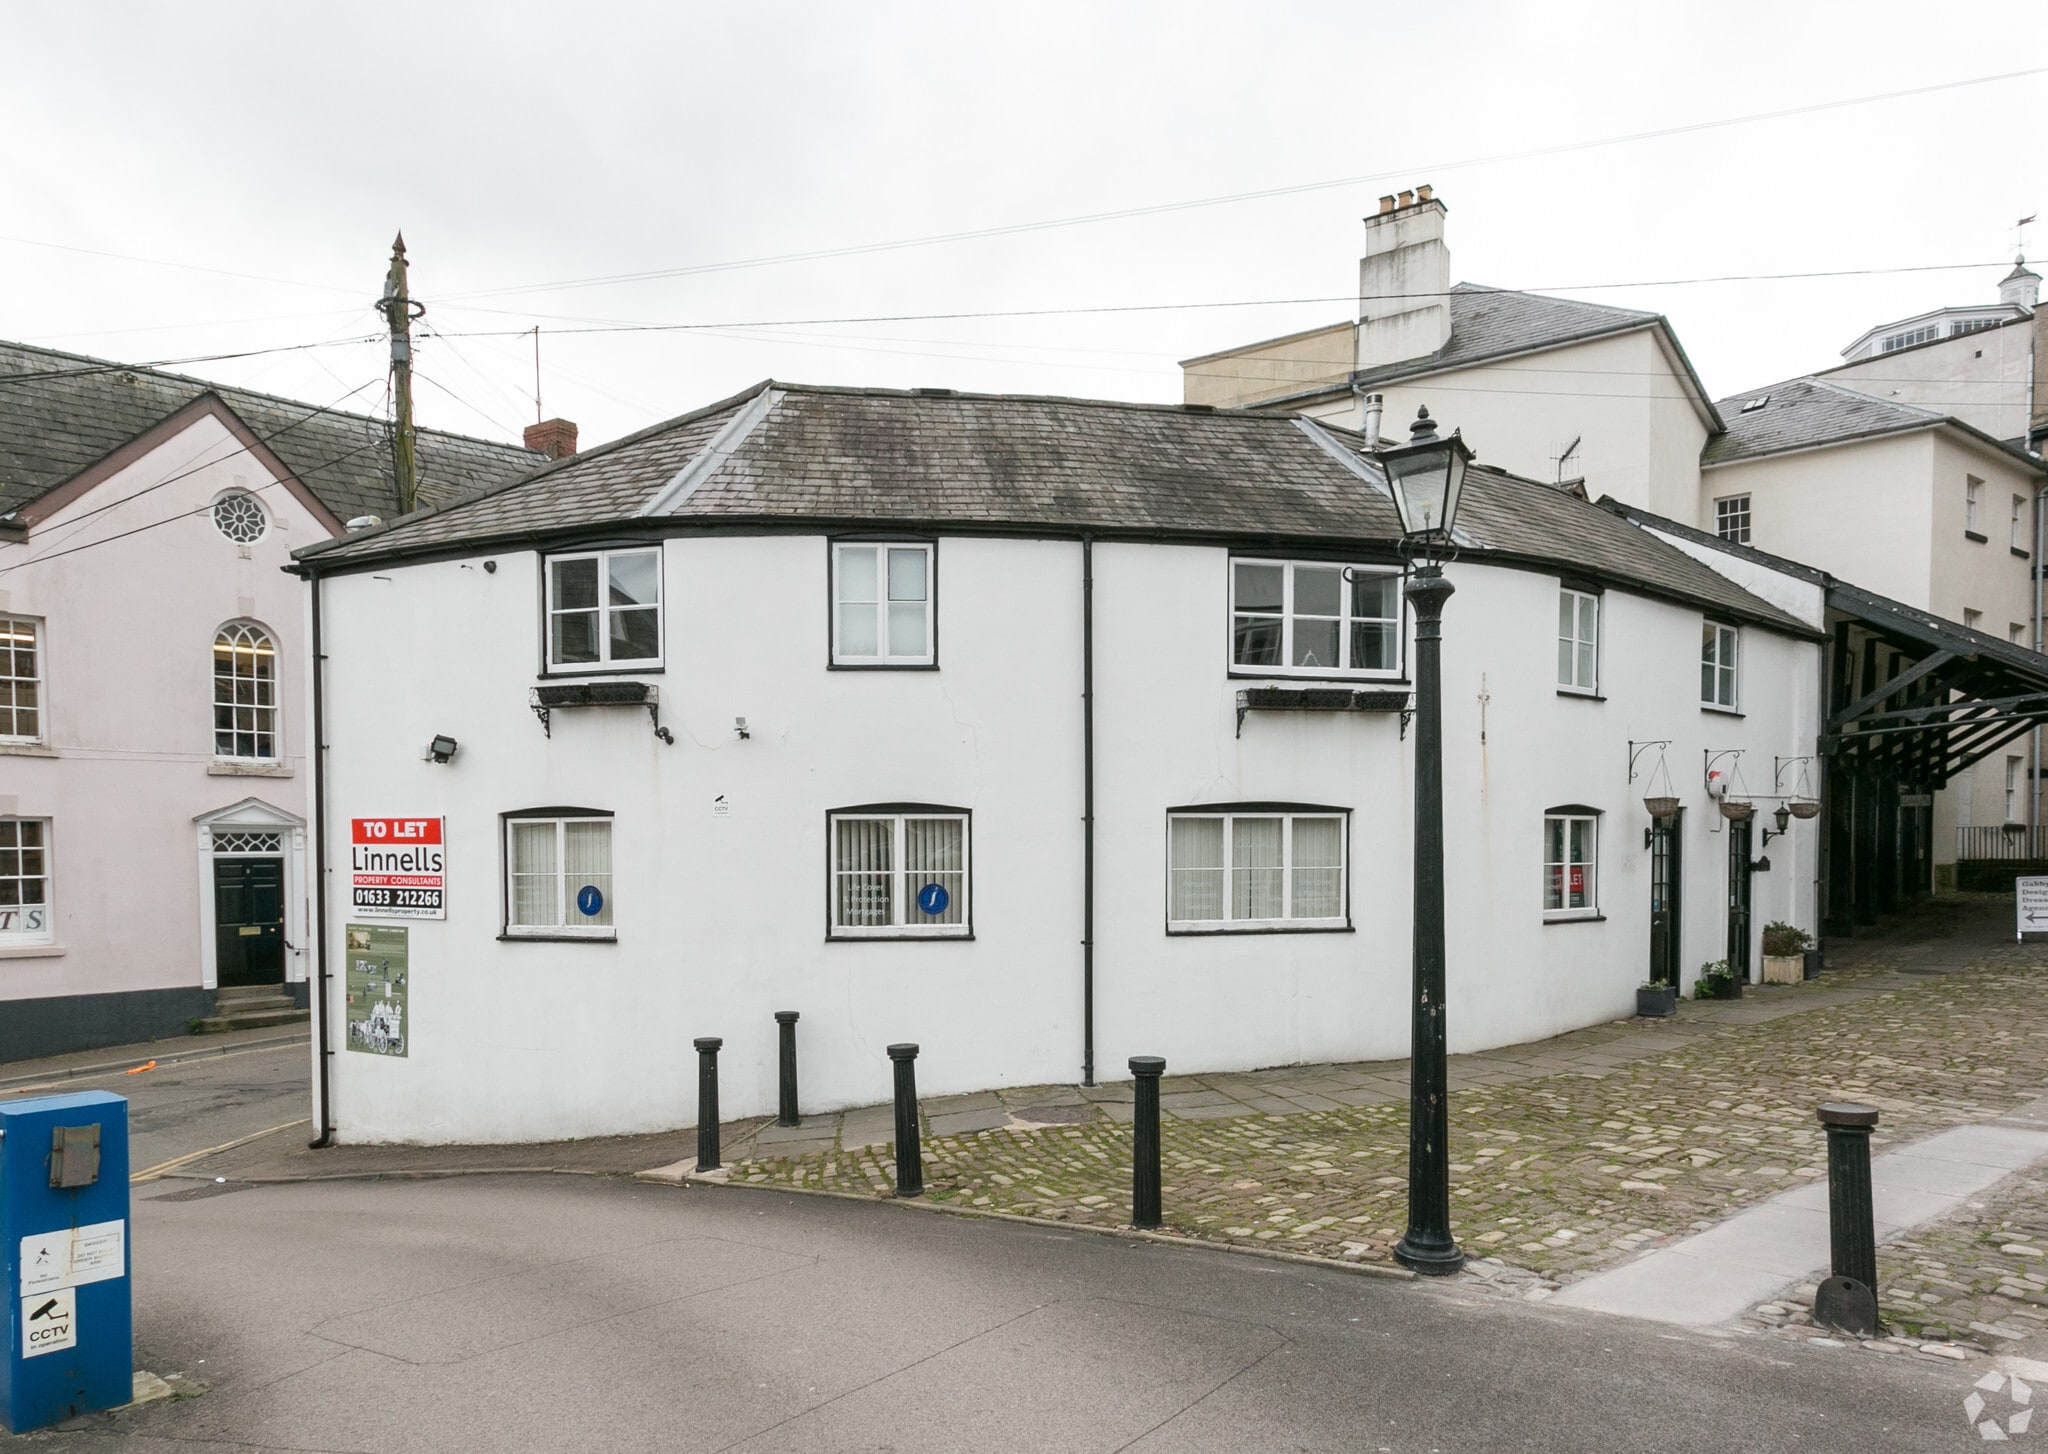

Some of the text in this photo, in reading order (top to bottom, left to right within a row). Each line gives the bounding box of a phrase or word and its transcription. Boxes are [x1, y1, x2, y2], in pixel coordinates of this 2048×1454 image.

[363, 821, 427, 838] TO LET
[352, 846, 443, 872] Linnells
[354, 875, 441, 886] PROPERTY CONSULTANTS
[356, 889, 440, 906] 01633 212266
[851, 895, 890, 903] Protection
[357, 906, 437, 916] www.linnellsproperty.co.uk
[847, 907, 886, 917] Mortgages
[30, 1324, 69, 1342] CCTV
[38, 1337, 69, 1349] operation
